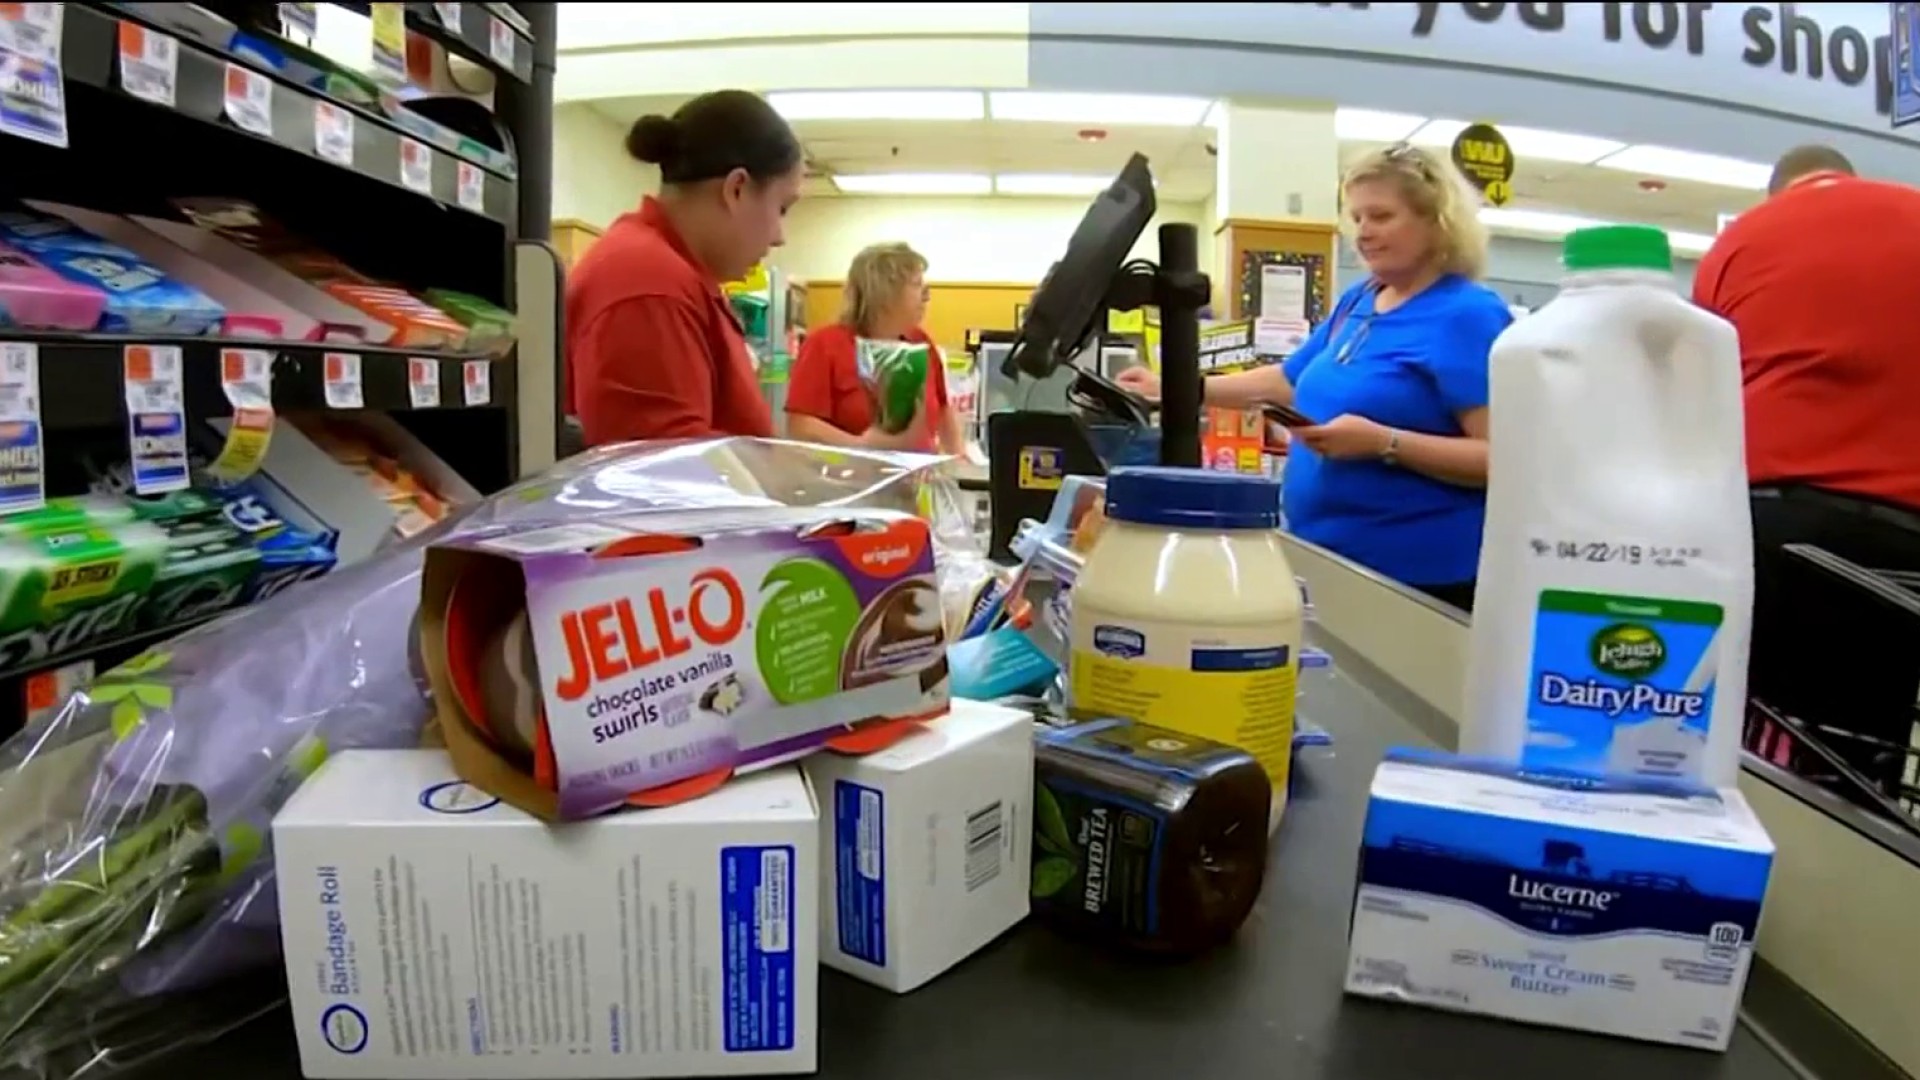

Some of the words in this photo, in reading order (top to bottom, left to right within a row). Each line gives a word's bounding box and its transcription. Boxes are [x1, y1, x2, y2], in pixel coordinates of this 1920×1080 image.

[586, 672, 676, 719] chocolate
[680, 652, 734, 684] vanilla
[592, 703, 660, 744] swirls
[1090, 808, 1109, 839] TEA
[316, 865, 341, 905] Roll
[1085, 842, 1104, 914] BREWED
[1507, 873, 1612, 912] Lucerne
[328, 910, 350, 996] Bandage
[1510, 974, 1572, 997] Butter
